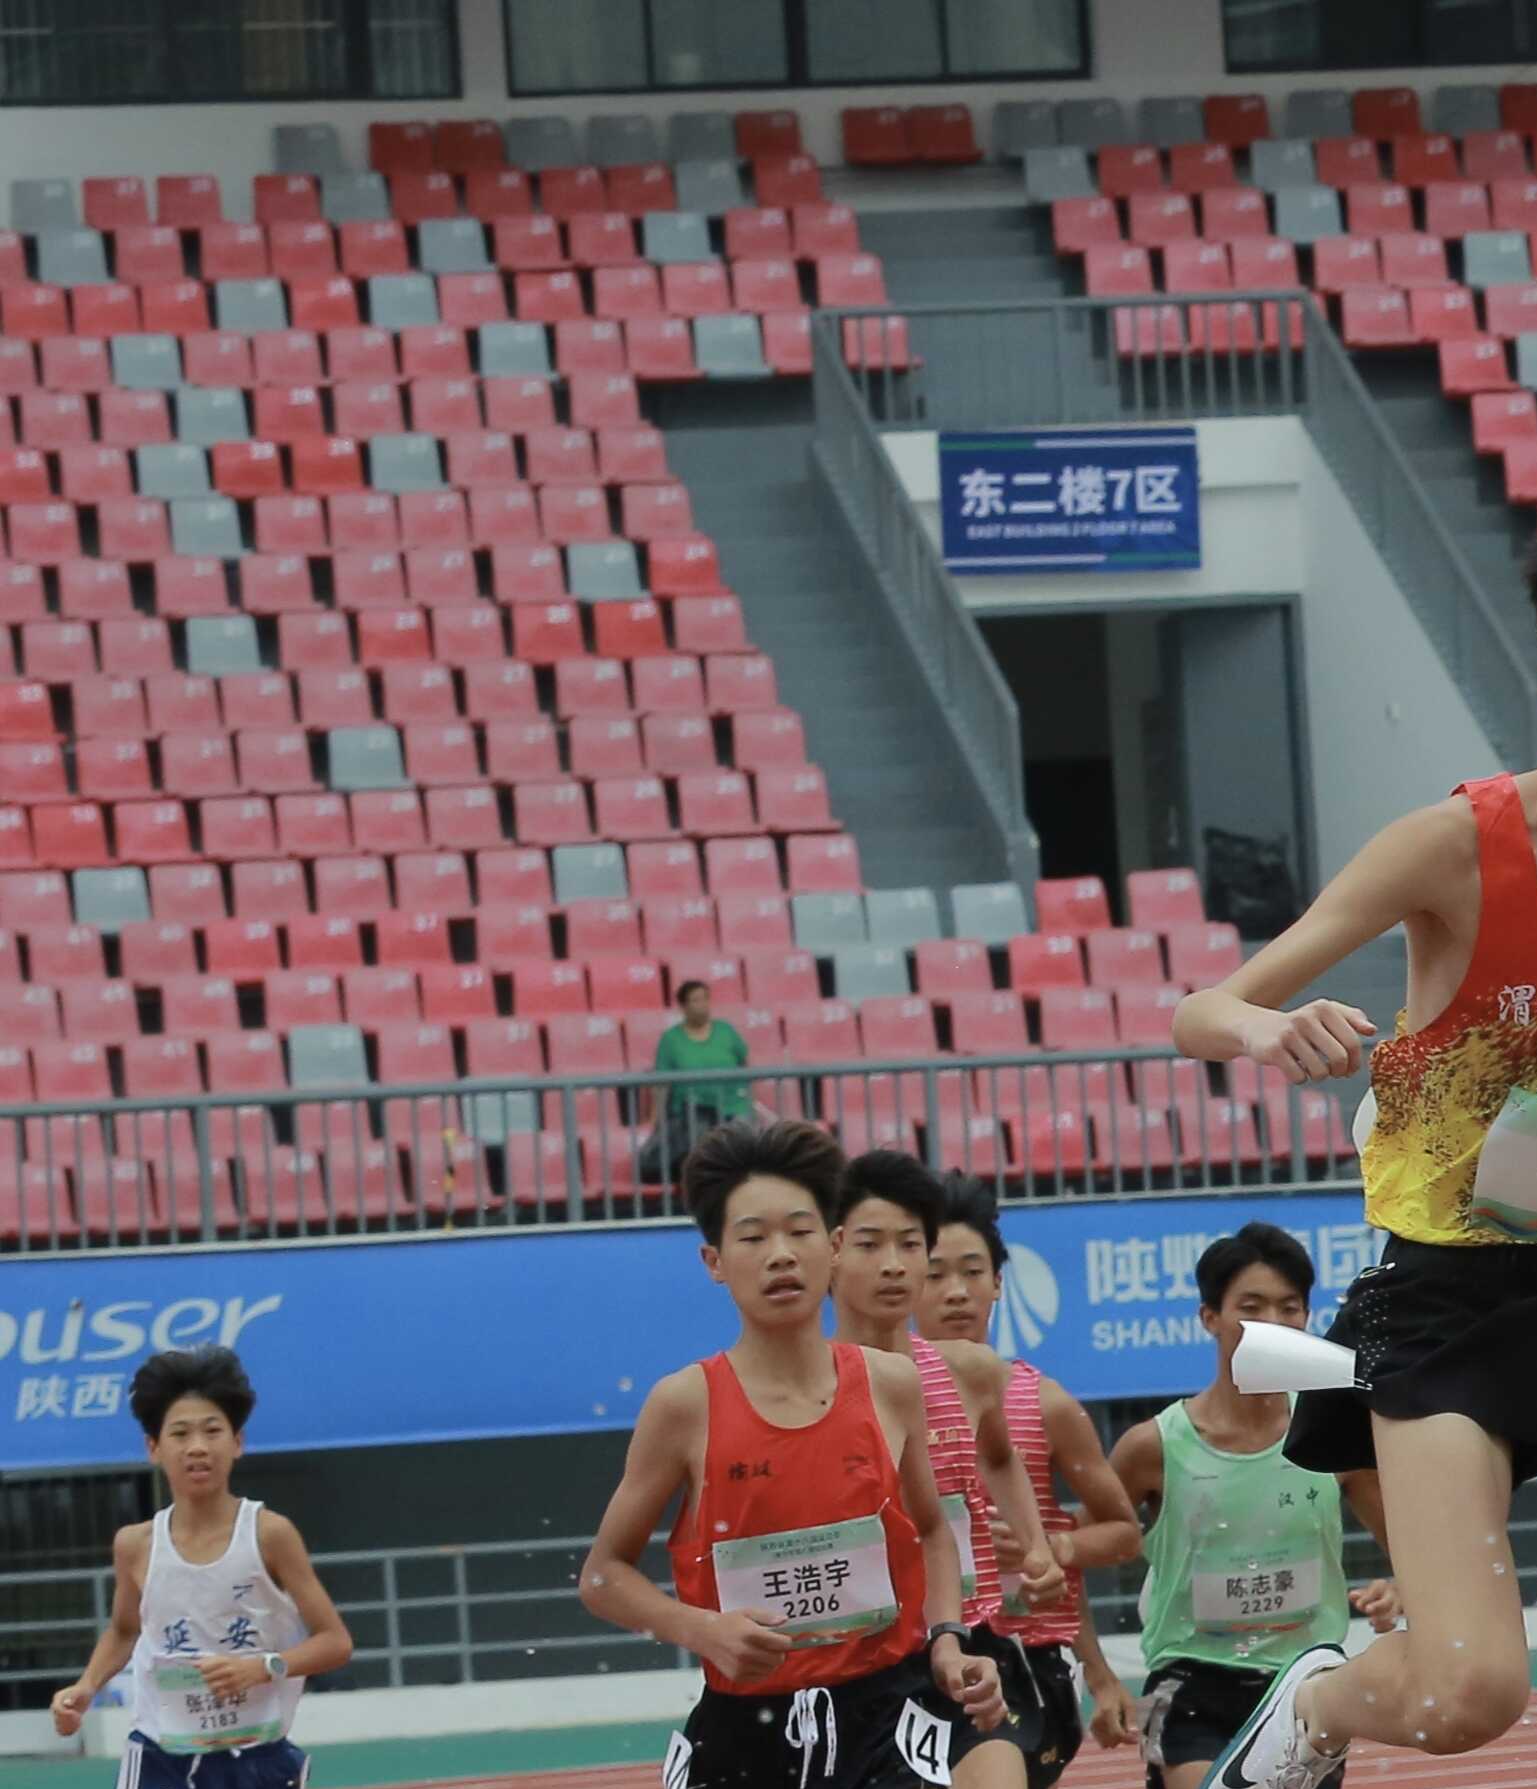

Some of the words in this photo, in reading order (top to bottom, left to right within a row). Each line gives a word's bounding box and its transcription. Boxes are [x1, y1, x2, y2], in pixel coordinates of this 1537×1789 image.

[959, 464, 1182, 518] 东二楼7区
[763, 1559, 851, 1599] 王浩宇
[1226, 1570, 1295, 1599] 陈志豪
[784, 1594, 840, 1619] 2206
[1241, 1596, 1284, 1615] 2229
[163, 1617, 260, 1654] 延安
[200, 1711, 239, 1729] 2183
[905, 1713, 940, 1776] 14
